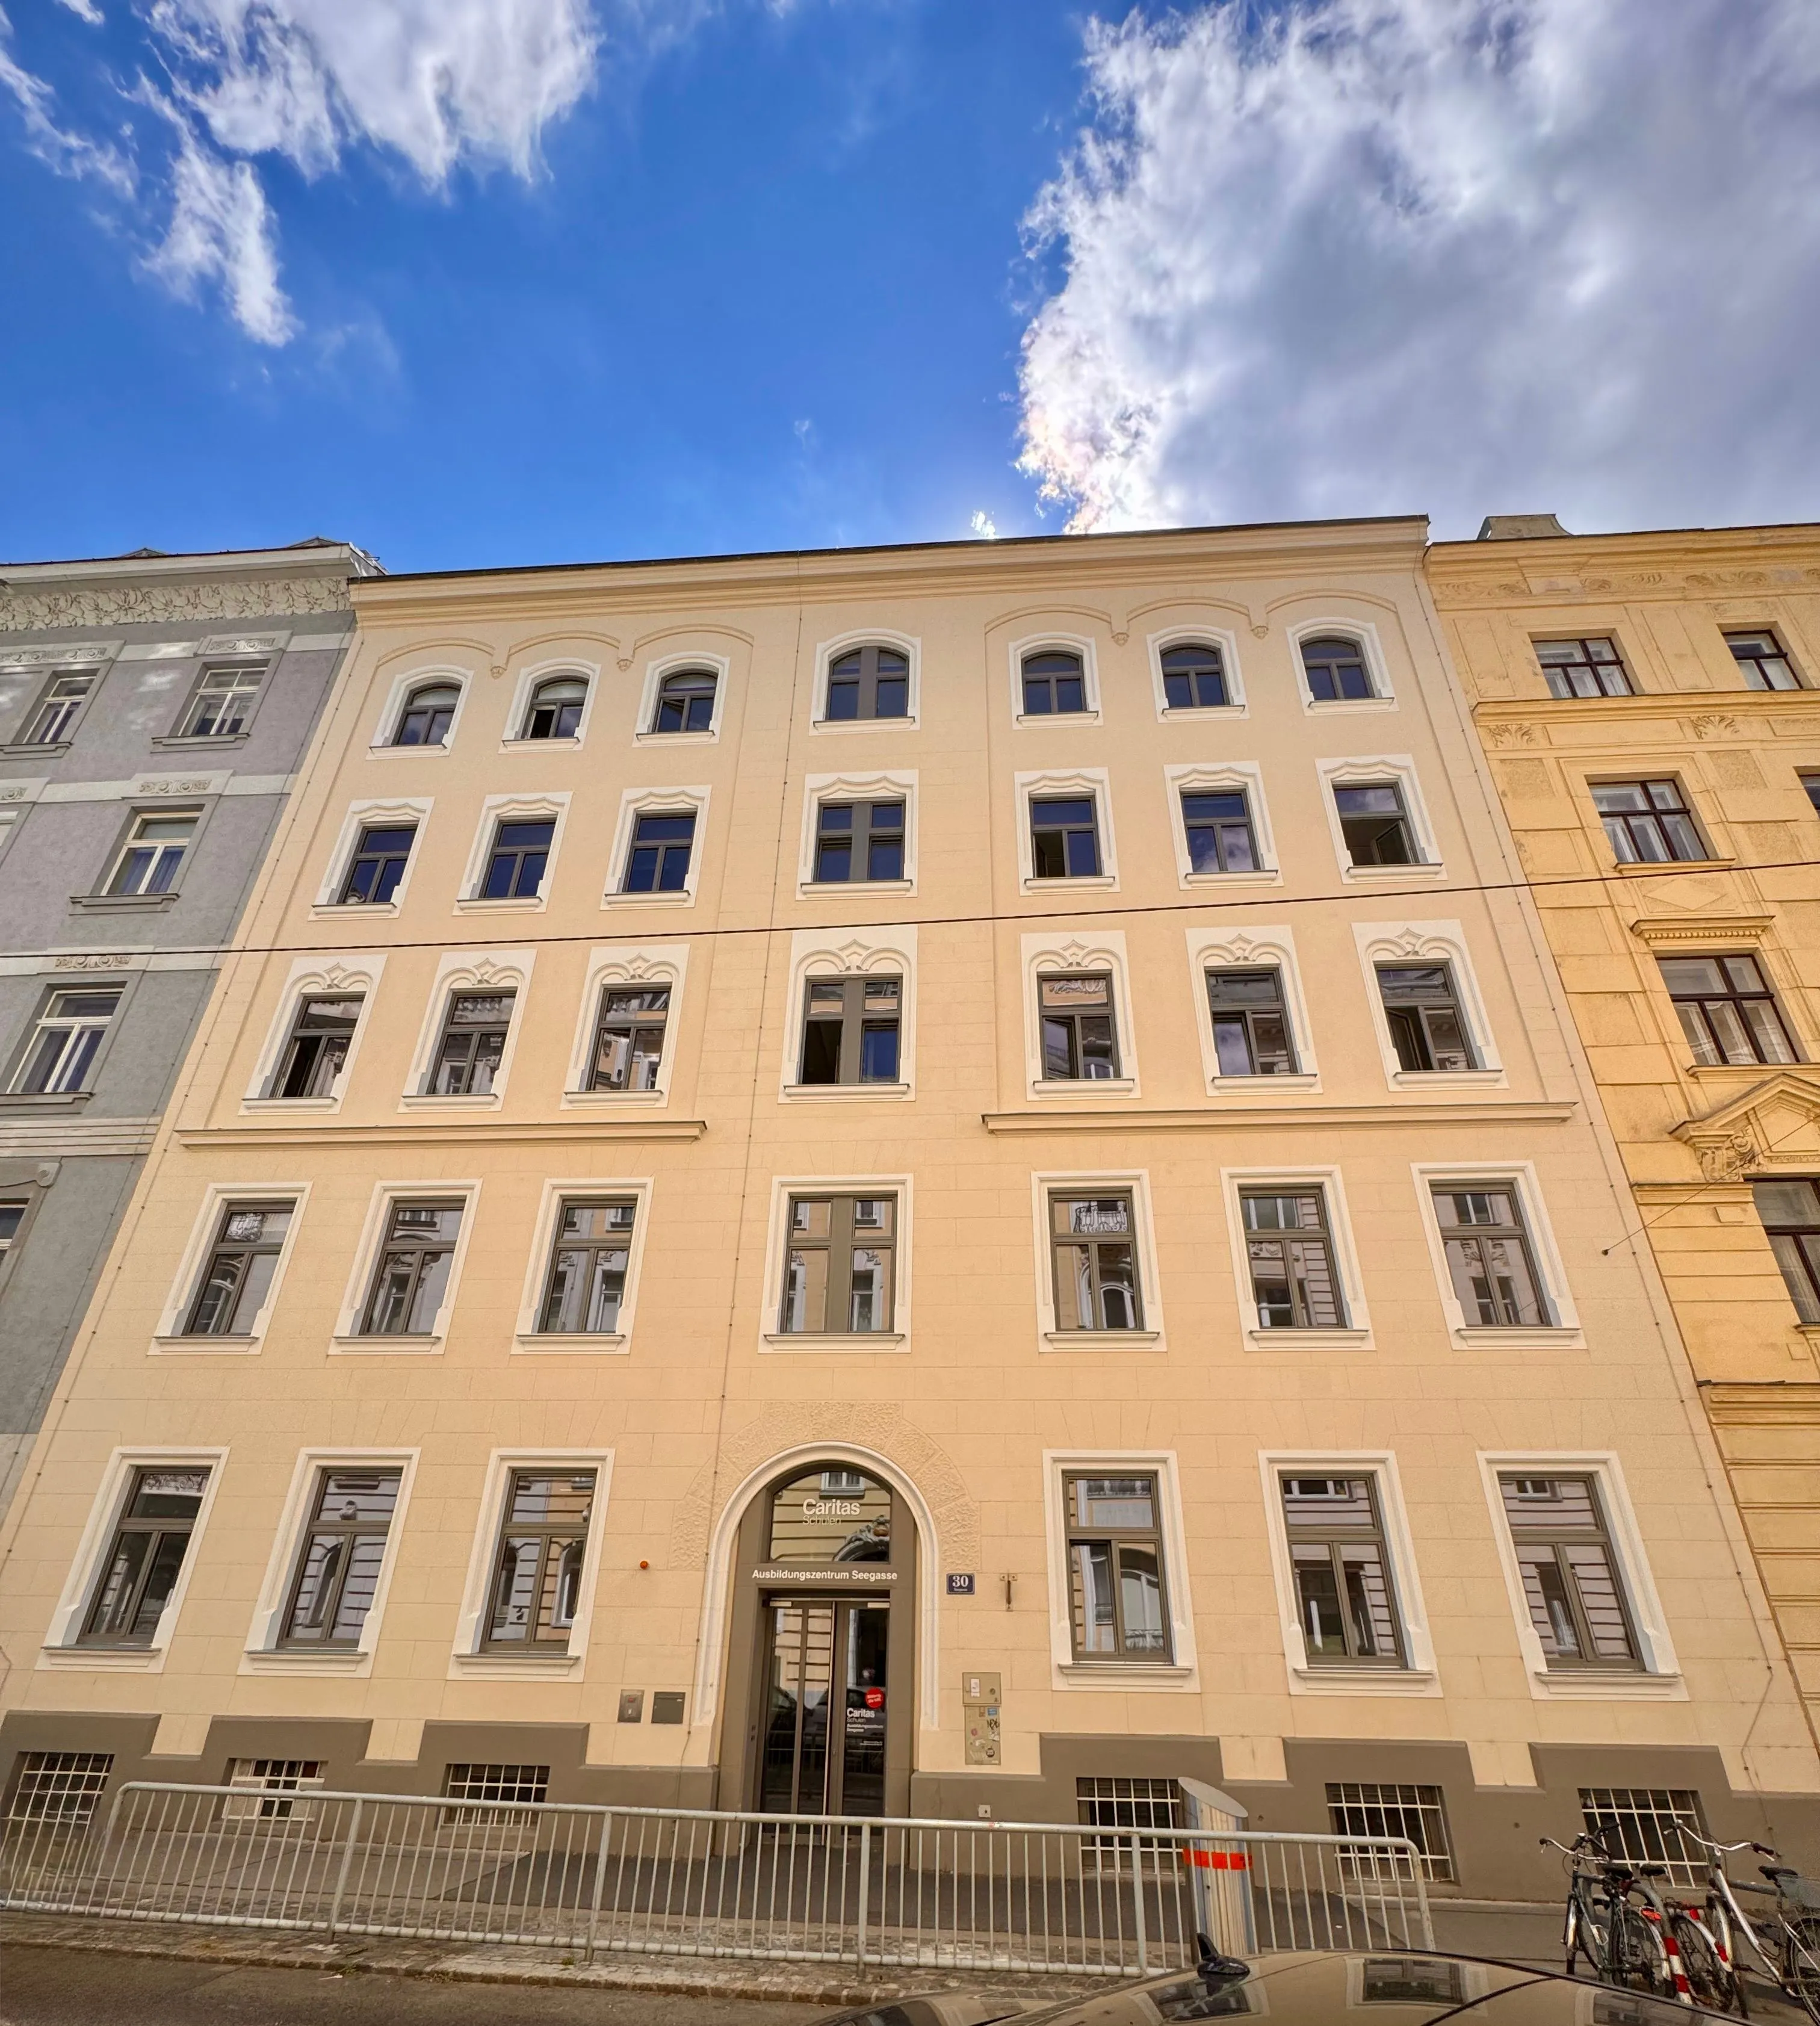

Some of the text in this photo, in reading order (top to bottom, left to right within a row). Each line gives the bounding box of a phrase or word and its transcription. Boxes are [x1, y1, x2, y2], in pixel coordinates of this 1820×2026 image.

[802, 1498, 861, 1516] Caritas
[802, 1516, 841, 1525] Schulen
[752, 1570, 898, 1582] Ausbildungszentrum Seegasse
[952, 1575, 969, 1587] 30
[846, 1708, 876, 1718] Caritas
